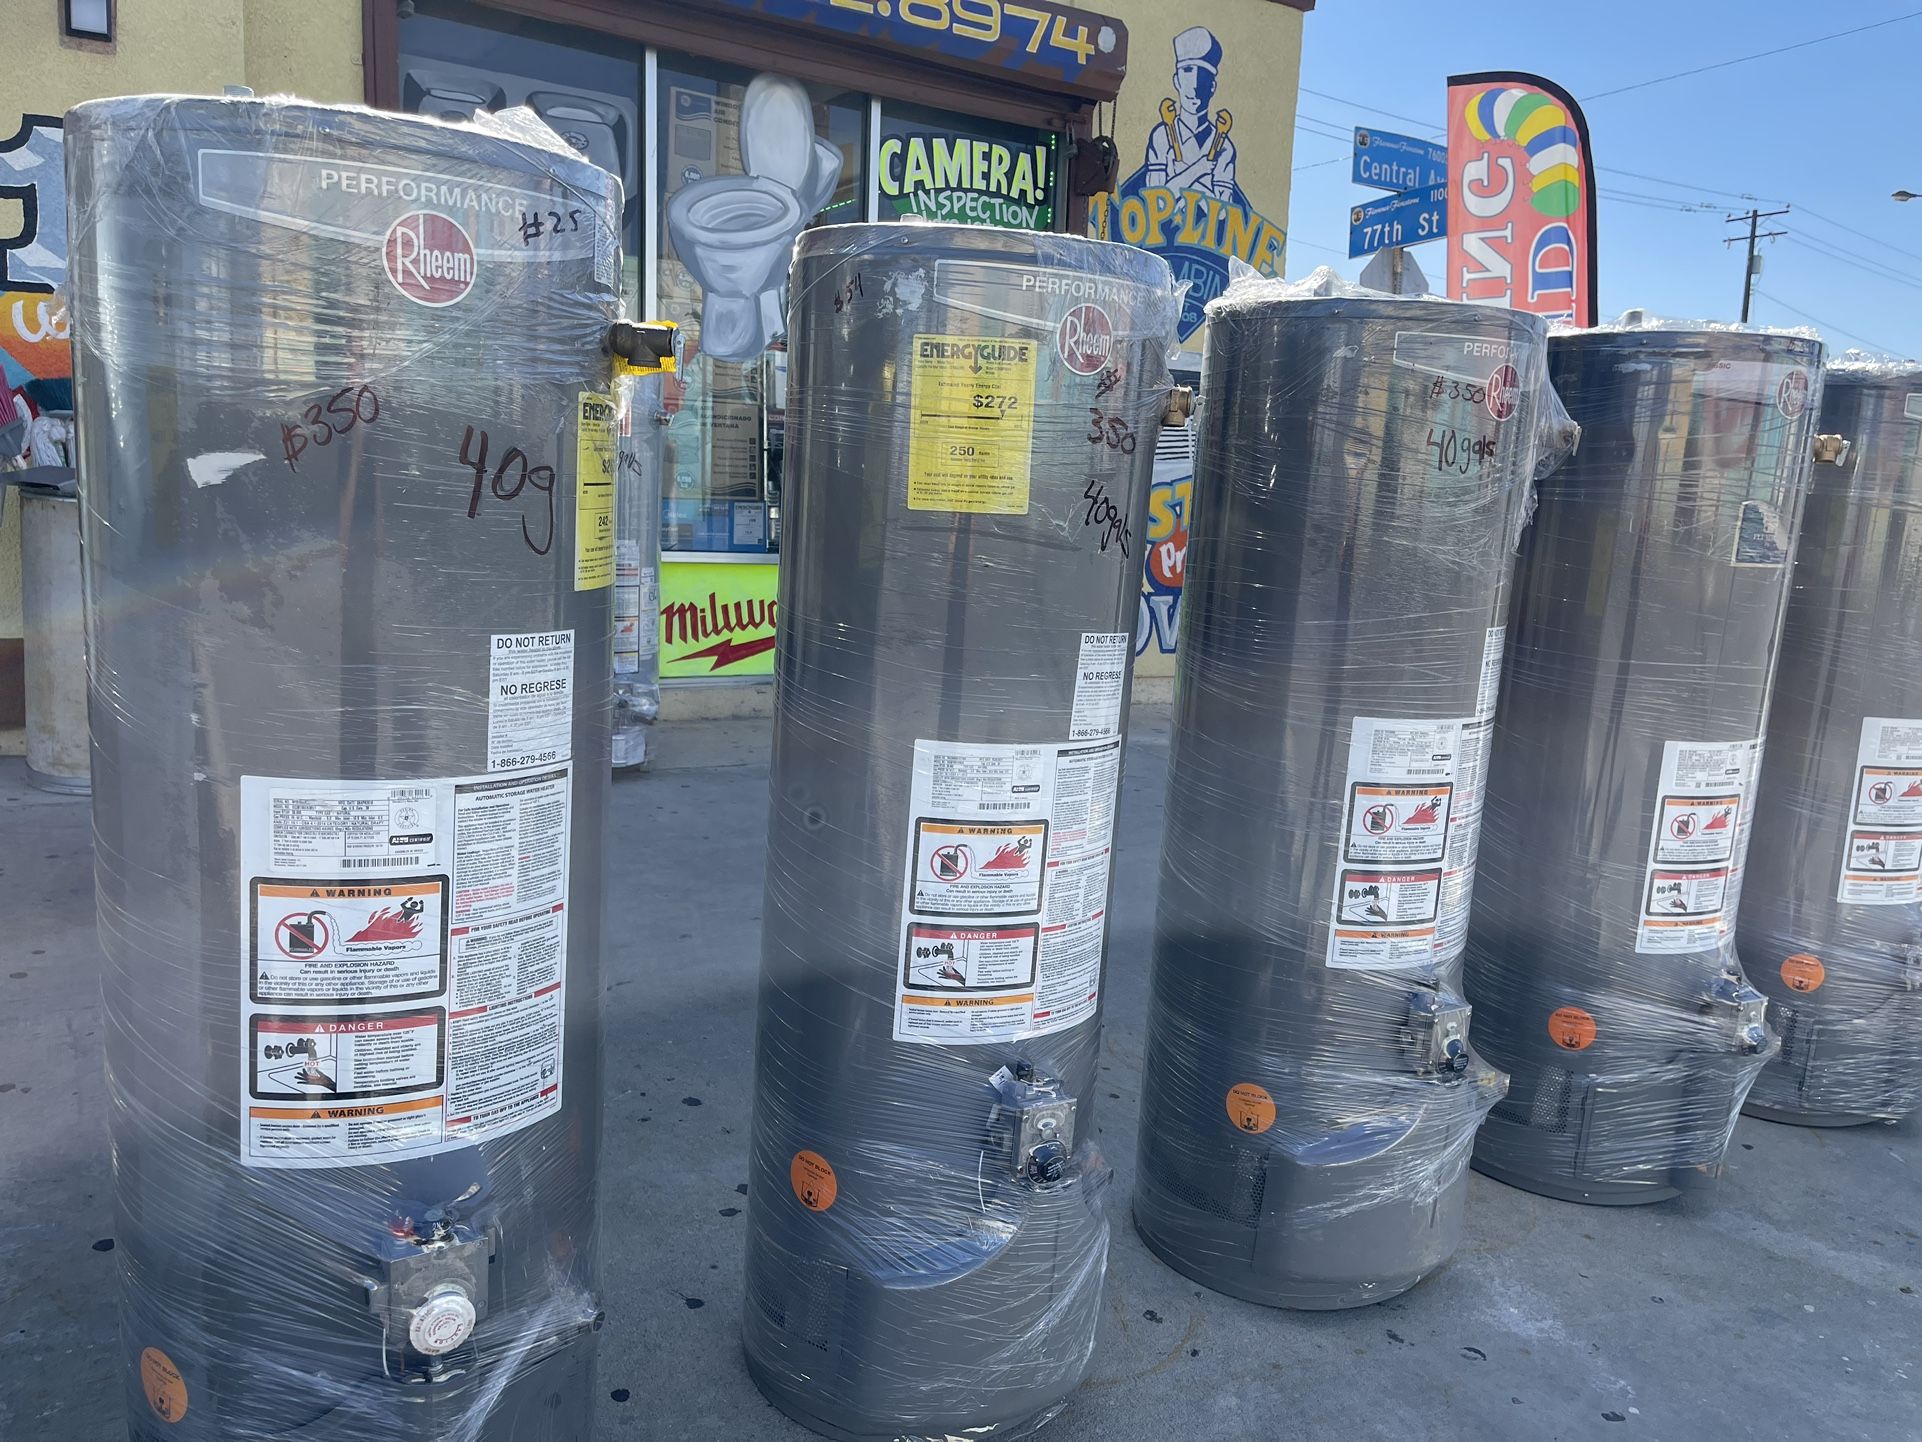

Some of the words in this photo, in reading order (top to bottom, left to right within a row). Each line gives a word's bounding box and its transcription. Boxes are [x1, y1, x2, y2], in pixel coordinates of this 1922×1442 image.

[879, 137, 1047, 204] CAMERA!
[1360, 155, 1420, 187] Central
[320, 169, 527, 216] PERFORMANCE
[909, 189, 1040, 229] INSPECTION
[518, 207, 583, 247] #25
[1363, 220, 1402, 250] 77th
[1418, 211, 1440, 236] St
[397, 212, 471, 290] Rheem
[1063, 306, 1111, 363] Rheem
[920, 342, 1029, 363] ENERGYGUIDE
[973, 394, 1018, 410] $272
[280, 384, 380, 473] $350
[1087, 407, 1137, 455] 350
[950, 446, 975, 456] 250
[459, 424, 556, 556] 40g
[497, 638, 513, 649] DO
[515, 636, 536, 649] NOT
[538, 633, 571, 647] RETURN
[1084, 635, 1095, 644] DO
[1096, 635, 1108, 644] NOT
[1109, 634, 1127, 643] RETURN
[1083, 671, 1094, 681] NO
[500, 684, 518, 696] NO
[520, 678, 567, 695] REGRESE
[491, 751, 557, 769] 1-866-279-4566
[475, 793, 504, 801] AUTOMATIC
[504, 790, 525, 798] STORAGE
[540, 784, 555, 792] HEATER
[326, 887, 392, 897] WARNING
[383, 944, 406, 952] Vapors
[329, 1021, 384, 1032] DANGER
[327, 1106, 384, 1118] WARNING
